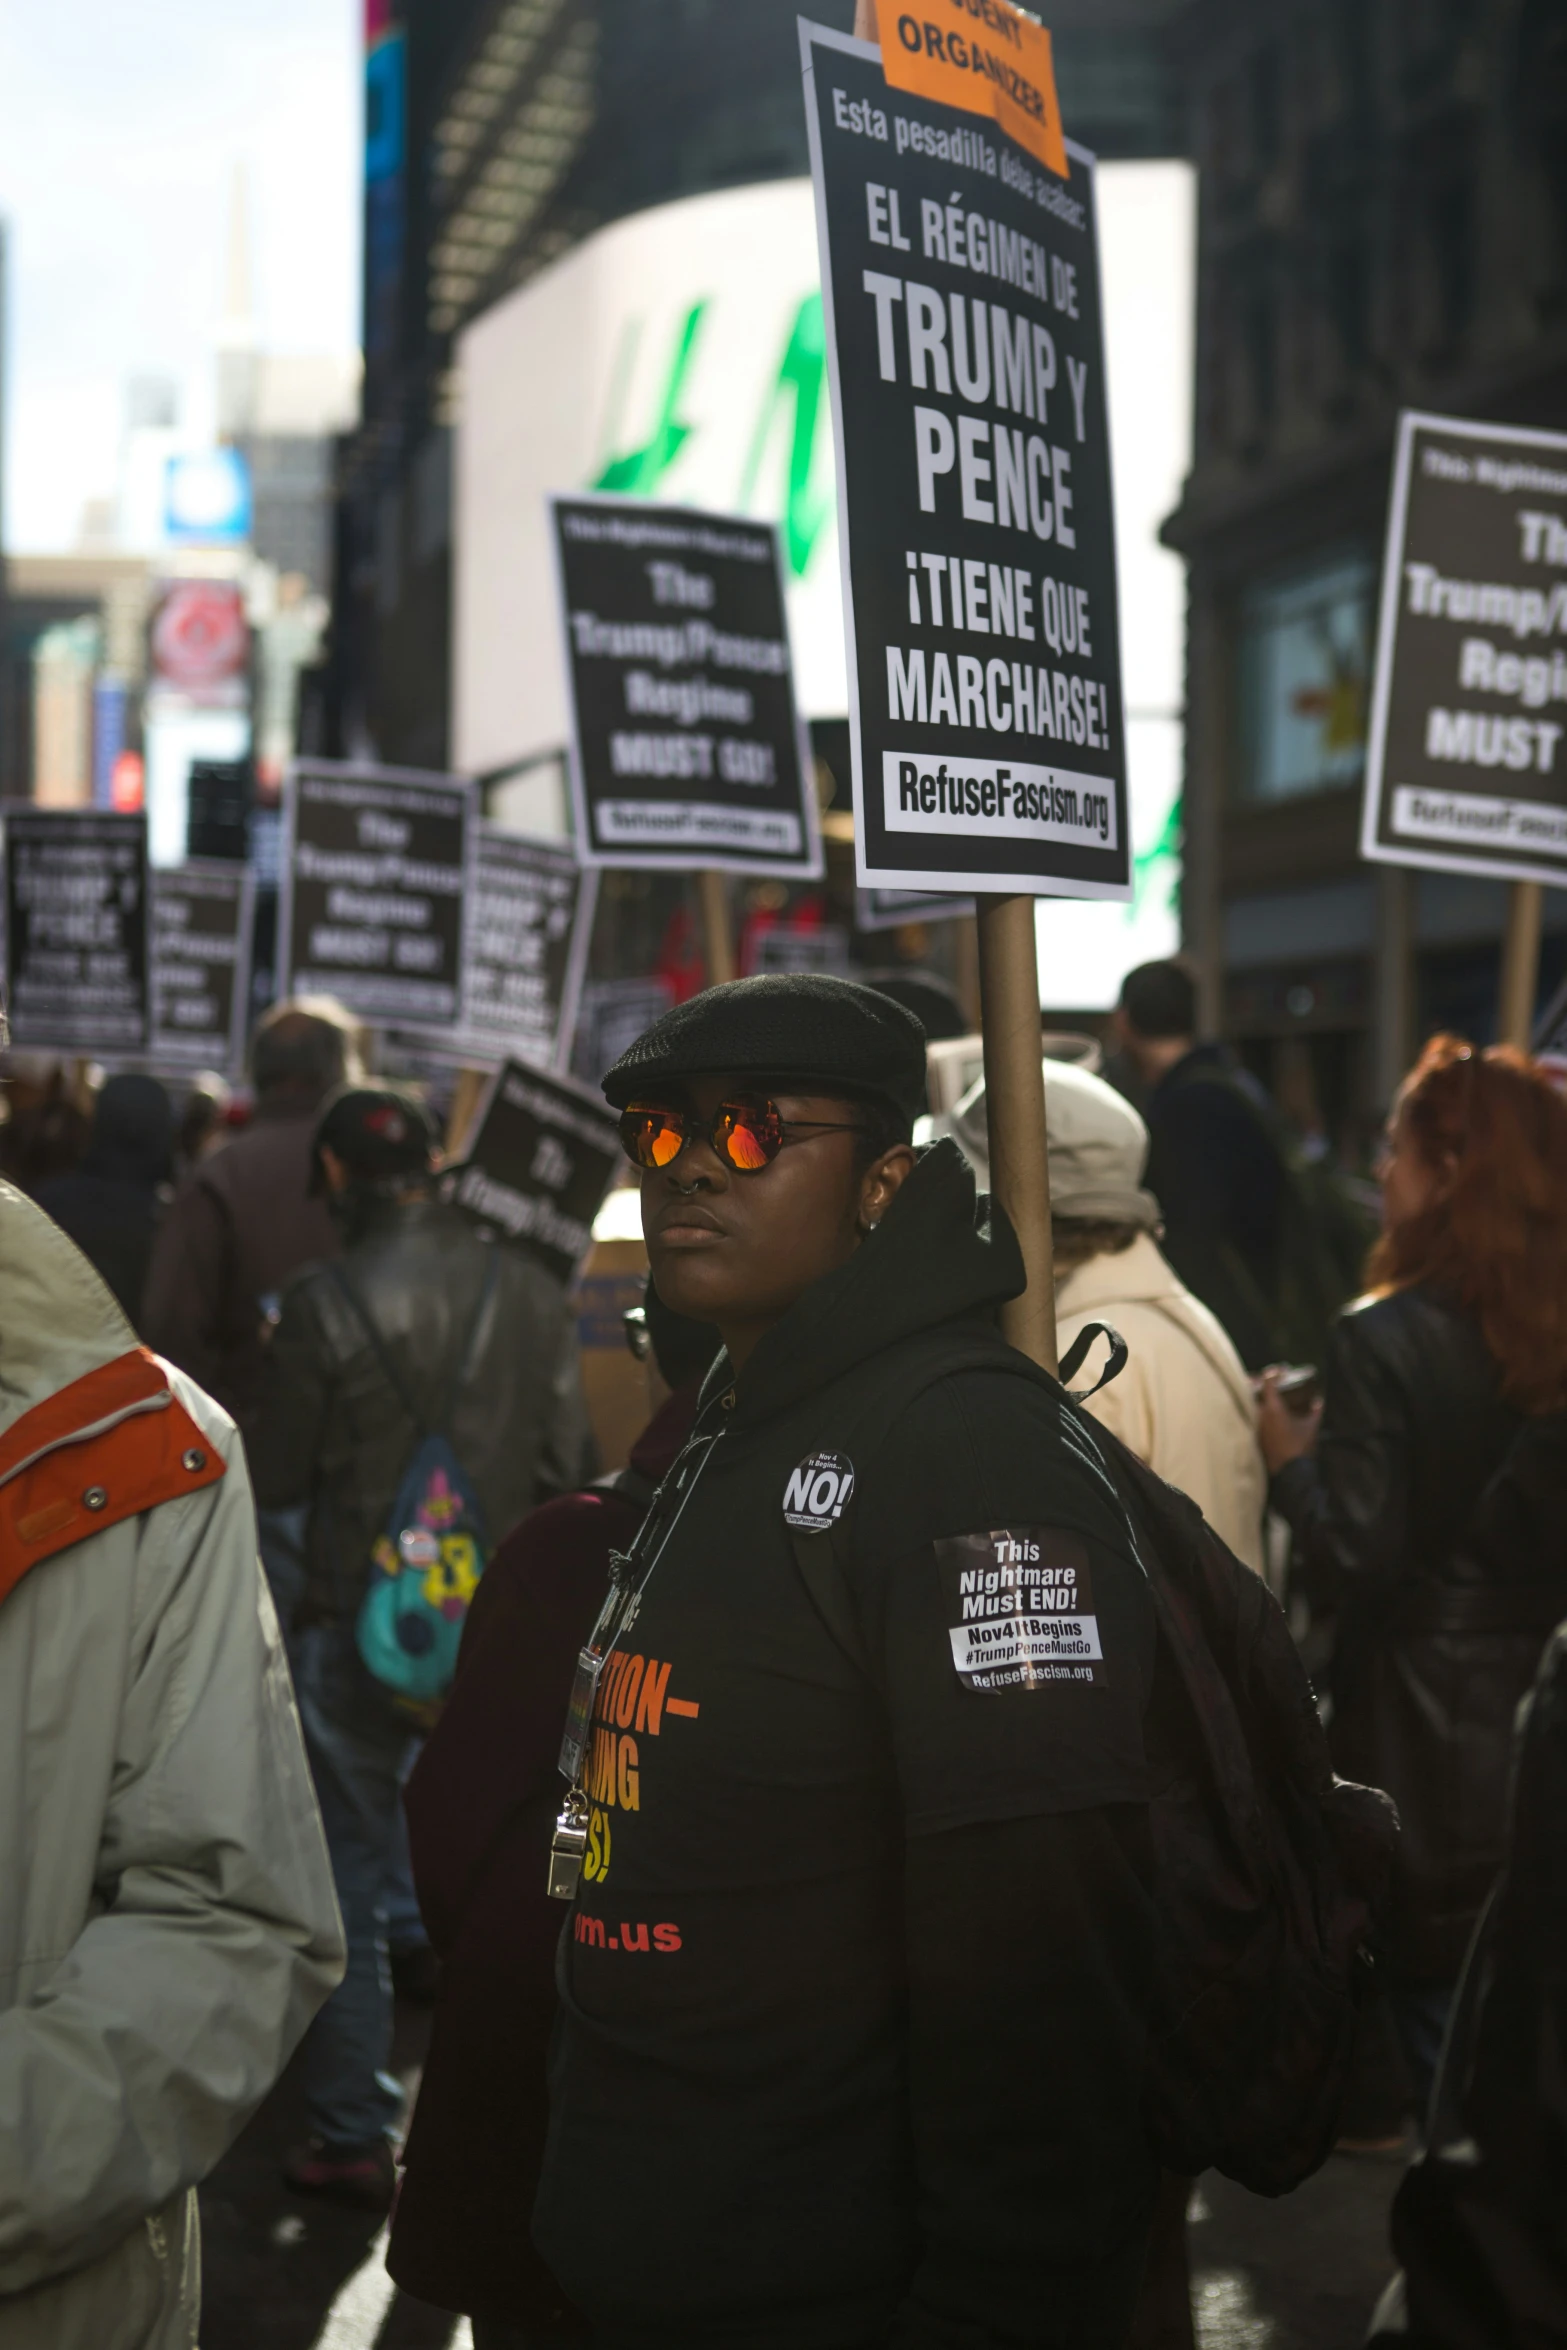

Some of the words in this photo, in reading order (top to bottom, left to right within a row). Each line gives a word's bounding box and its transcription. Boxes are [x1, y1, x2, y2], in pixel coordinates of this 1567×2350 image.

[953, 0, 1022, 50] DENT
[898, 14, 1047, 128] ORGANIZER
[832, 87, 888, 141] Esta
[894, 115, 996, 177] pesadilla
[866, 181, 911, 251] EL
[921, 191, 1048, 302] RÉGIMEN
[1051, 255, 1079, 321] DE
[863, 269, 1057, 425] TRUMP
[1065, 355, 1088, 443] Y
[914, 405, 1077, 550] PENCE
[1517, 509, 1567, 566] Th
[905, 550, 1036, 642] ¡TIENE
[1041, 576, 1093, 658] QUE
[885, 646, 1110, 751] MARCHARSE!
[1458, 636, 1567, 709] Regi
[1425, 706, 1563, 775] MUST
[899, 760, 1109, 841] RefuseFascism.org
[818, 1453, 832, 1461] Nov
[782, 1467, 853, 1518] NO!
[960, 1565, 1076, 1595] Nightmare
[994, 1539, 1040, 1563] This
[962, 1589, 1023, 1620] Must
[1030, 1588, 1078, 1610] END!
[966, 1640, 1091, 1665] #TrumpPenceMustGo
[972, 1664, 1094, 1688] RefuseFascism.org
